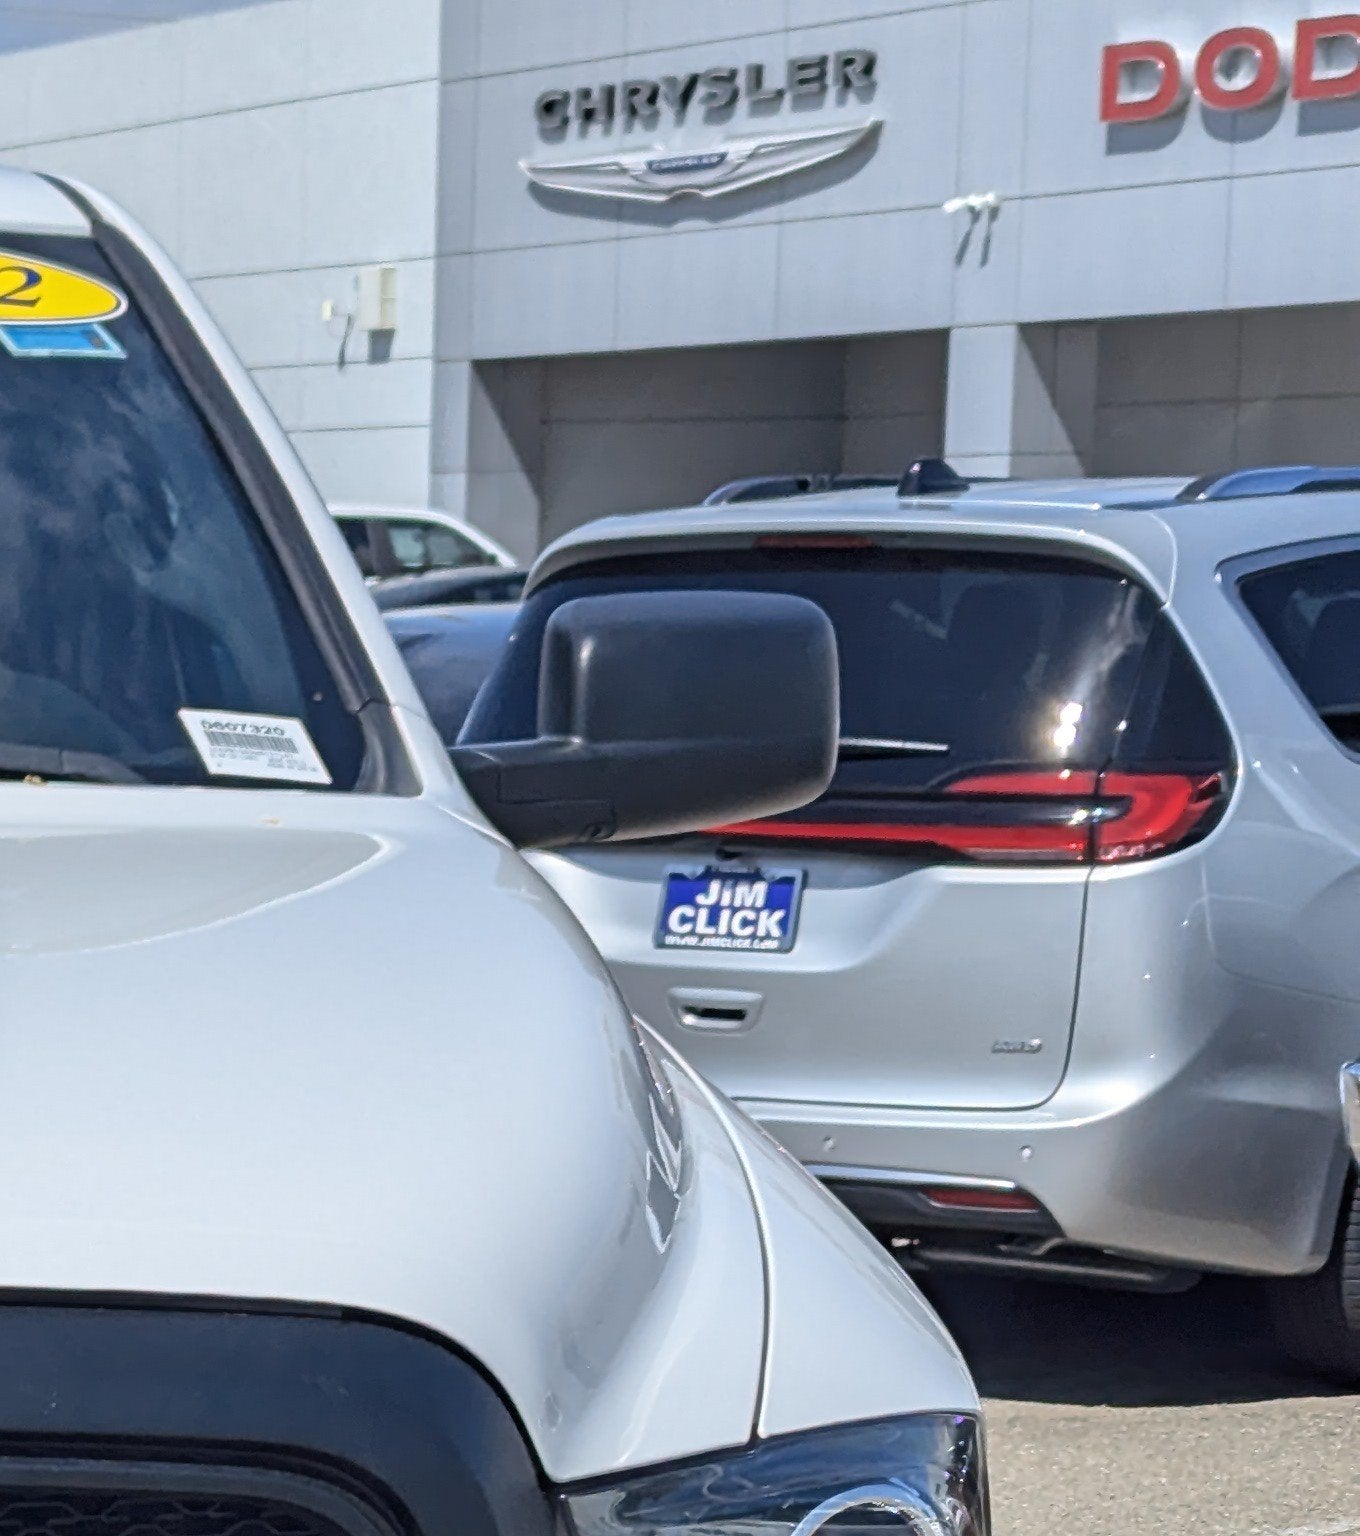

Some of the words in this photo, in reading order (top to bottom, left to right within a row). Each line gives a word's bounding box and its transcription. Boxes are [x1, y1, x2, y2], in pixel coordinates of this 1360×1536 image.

[535, 49, 878, 131] CHRYSLER
[695, 879, 769, 908] JIM
[668, 905, 785, 938] CLICK
